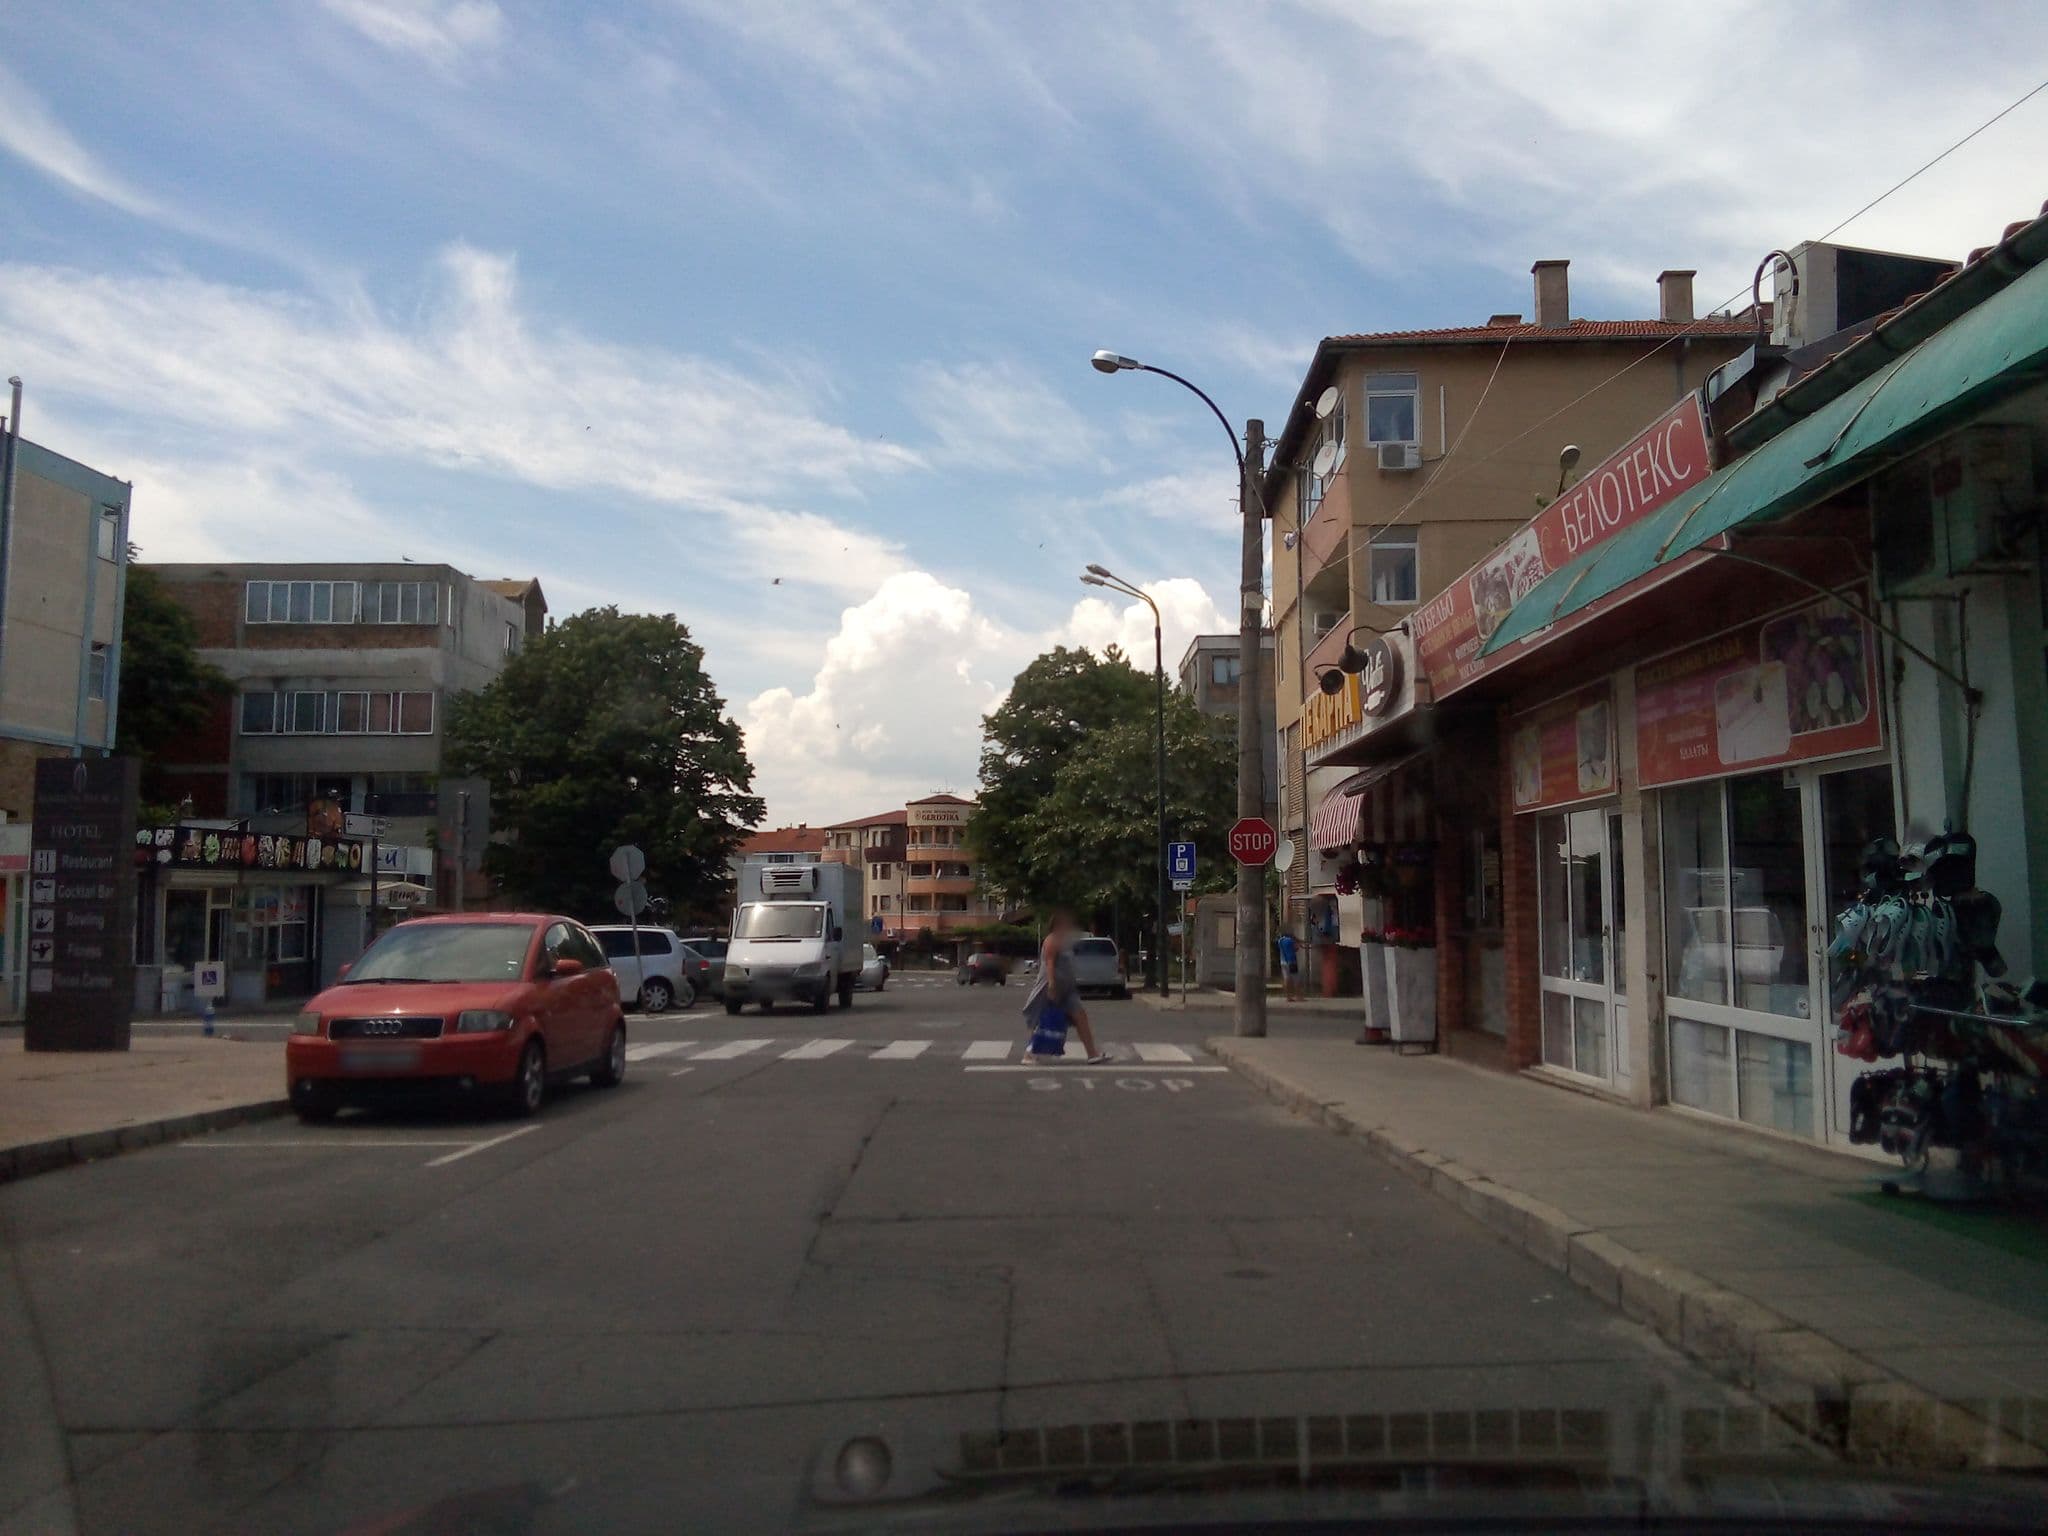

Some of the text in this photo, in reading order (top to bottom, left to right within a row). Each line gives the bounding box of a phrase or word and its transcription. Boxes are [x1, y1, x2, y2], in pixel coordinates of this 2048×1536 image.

[1560, 418, 1691, 553] БЕЛОТЕКС
[1425, 592, 1454, 631] БЕЛЬО
[50, 824, 102, 840] HOTEL
[1233, 833, 1272, 851] STOP
[1177, 844, 1186, 858] P
[62, 855, 113, 869] Restaurant
[97, 884, 114, 898] Bar
[1026, 1077, 1195, 1092] STOP
